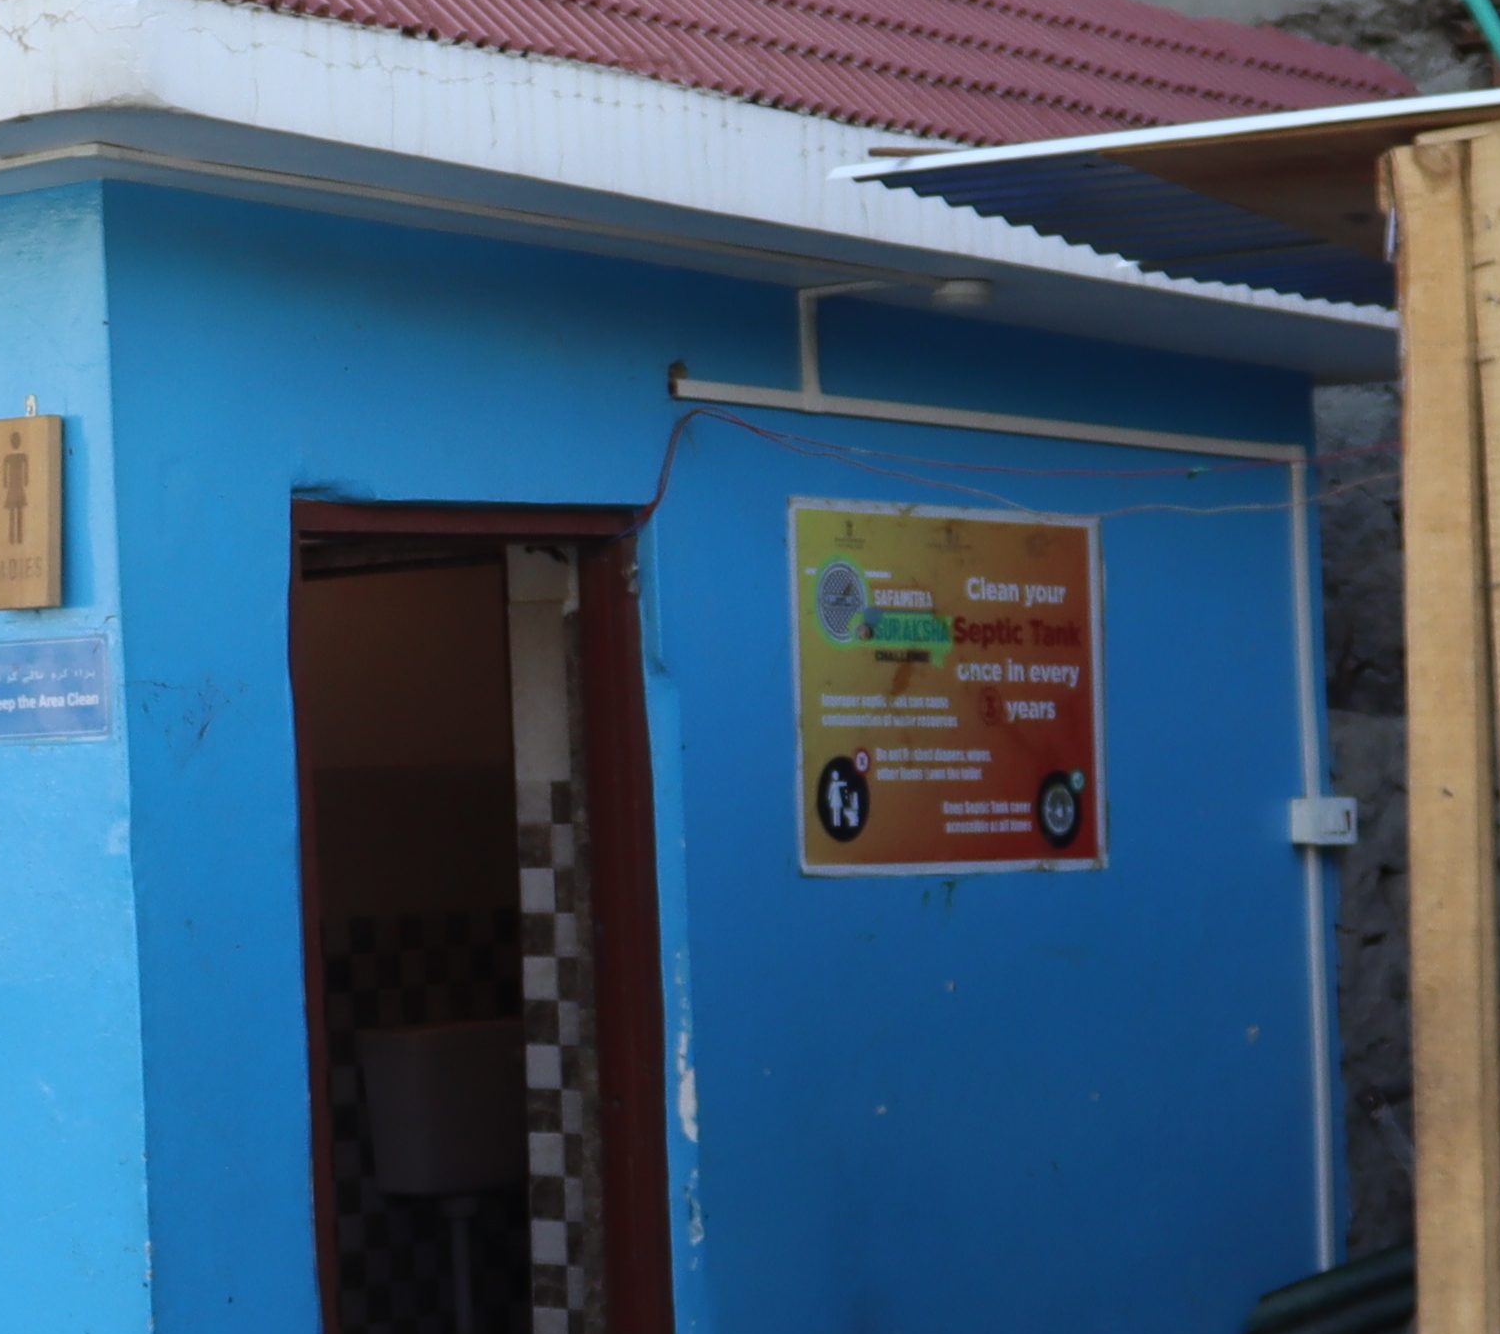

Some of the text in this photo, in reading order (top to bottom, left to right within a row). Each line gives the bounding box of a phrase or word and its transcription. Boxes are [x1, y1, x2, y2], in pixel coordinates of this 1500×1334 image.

[966, 577, 1066, 607] Clean your
[954, 617, 1081, 650] Septic Tank
[1007, 658, 1025, 682] in
[1030, 665, 1080, 688] every
[17, 694, 36, 709] the
[39, 694, 65, 707] Area
[67, 692, 99, 706] Clean
[1006, 700, 1056, 722] years
